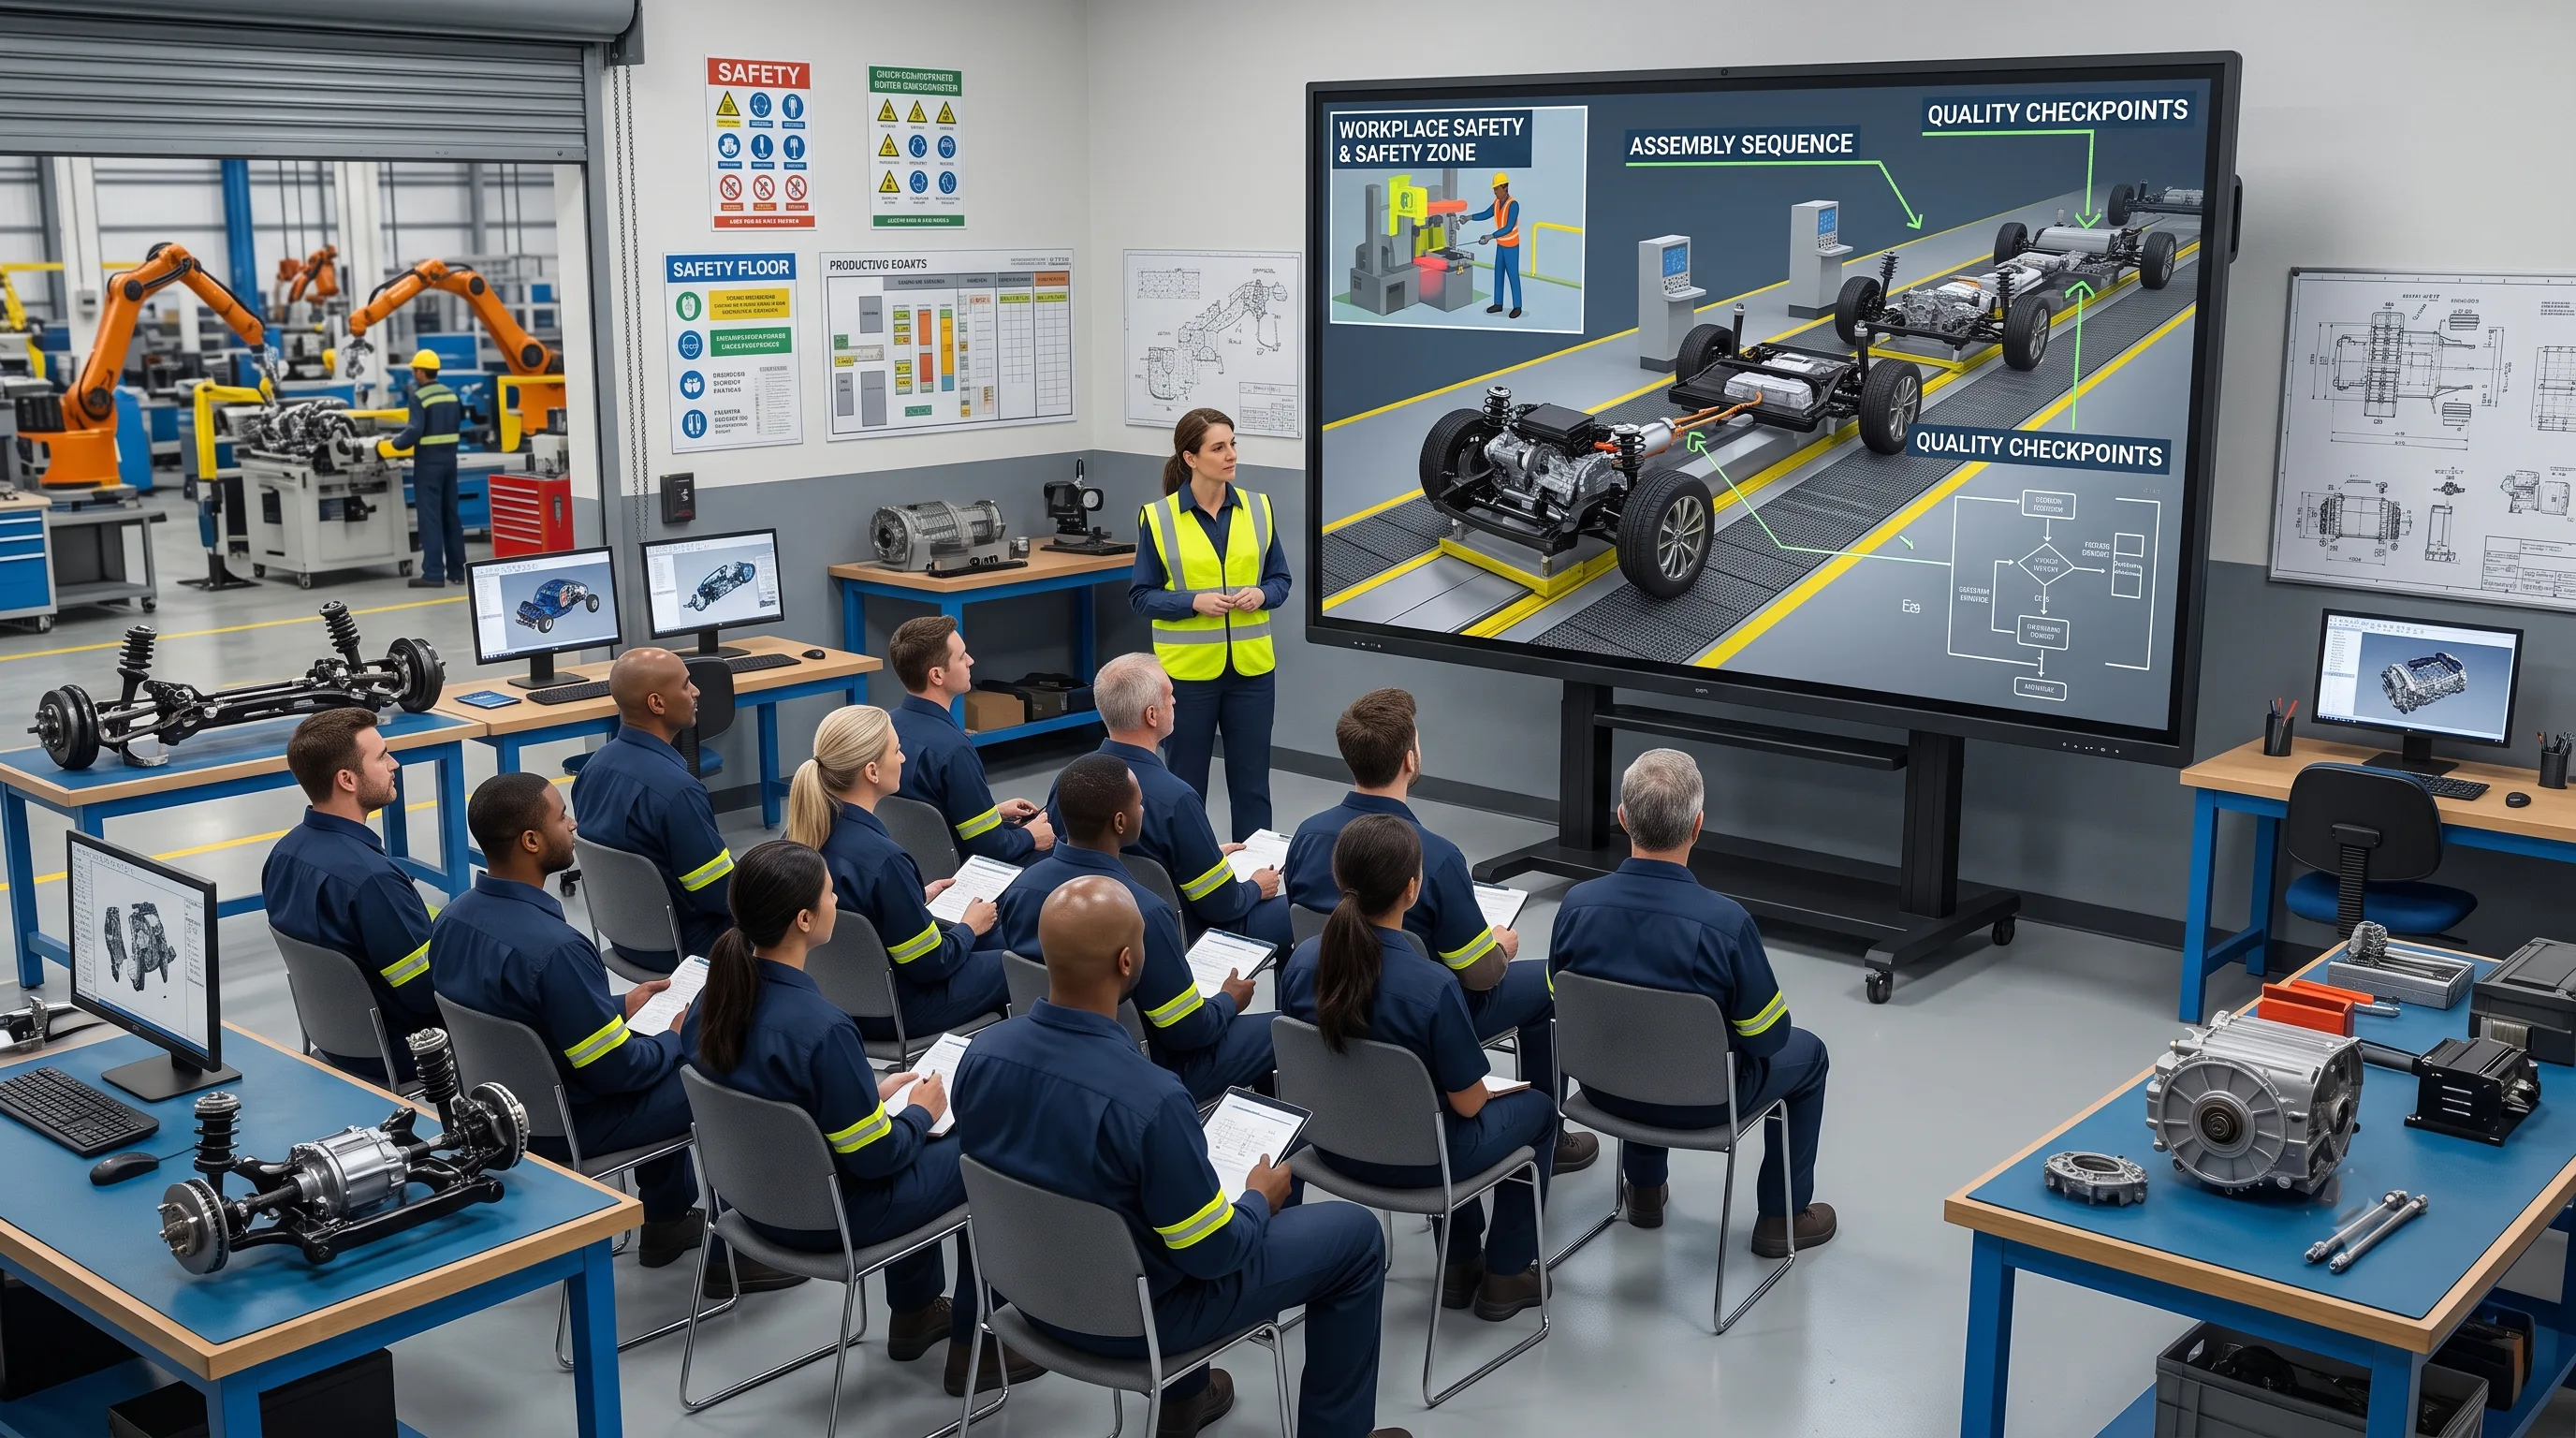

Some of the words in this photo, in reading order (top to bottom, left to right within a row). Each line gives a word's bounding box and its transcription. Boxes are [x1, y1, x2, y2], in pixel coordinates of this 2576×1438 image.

[718, 62, 800, 85] SAFETY
[1927, 103, 2021, 127] QUALITY
[2026, 98, 2188, 123] CHECKPOINTS
[1339, 119, 1449, 139] WORKPLACE
[1453, 117, 1525, 138] SAFETY
[1339, 144, 1351, 163] &
[1355, 143, 1423, 163] SAFETY
[1427, 142, 1476, 162] ZONE
[1629, 135, 1736, 155] ASSEMBLY
[1741, 133, 1853, 157] SEQUENCE
[673, 260, 734, 278] SAFETY
[738, 259, 790, 276] FLOOR
[1916, 432, 2004, 455] QUALITY
[2009, 438, 2163, 467] CHECKPOINTS
